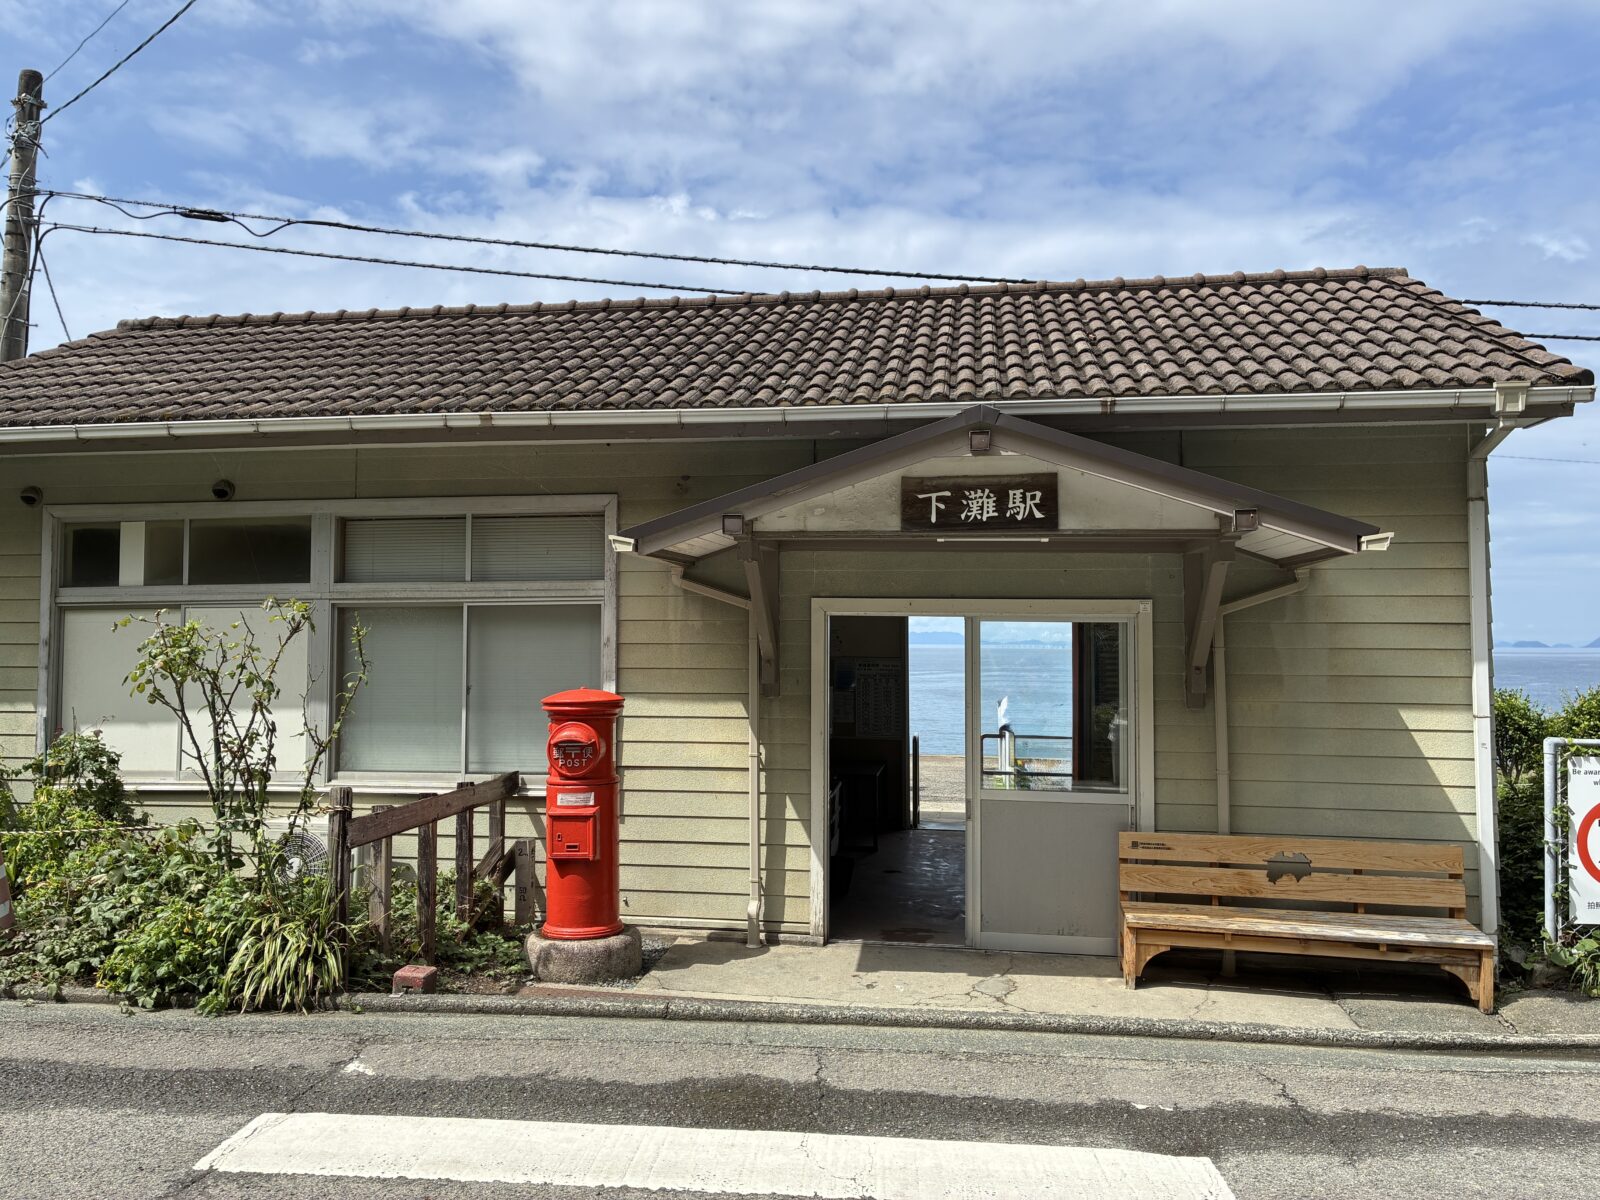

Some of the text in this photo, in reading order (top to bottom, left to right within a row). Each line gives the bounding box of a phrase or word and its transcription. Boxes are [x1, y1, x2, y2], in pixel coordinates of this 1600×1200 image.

[916, 488, 1046, 524] 下灘駅
[558, 758, 588, 768] POST
